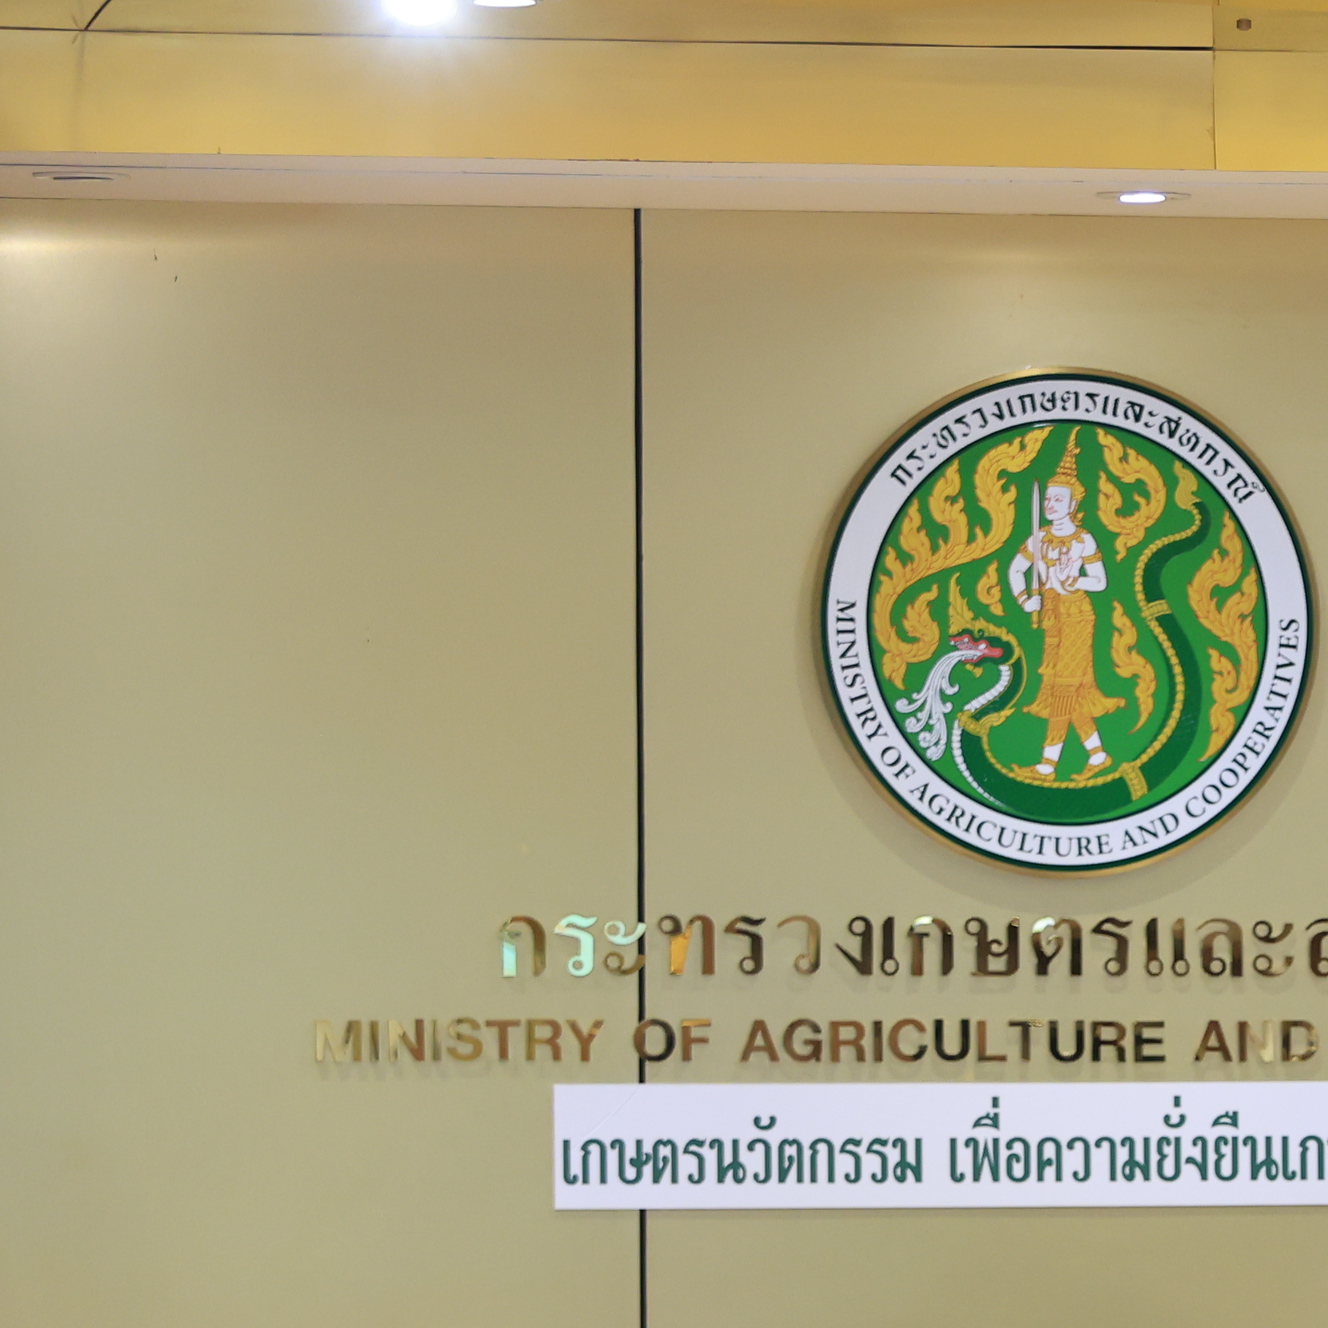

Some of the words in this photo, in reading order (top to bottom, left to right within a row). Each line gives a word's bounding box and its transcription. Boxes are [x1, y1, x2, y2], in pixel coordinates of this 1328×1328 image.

[890, 390, 1266, 504] กระทรวงเกษตรและสหกรณ์
[836, 599, 890, 742] MINISTRY
[880, 745, 916, 780] OF
[909, 781, 1114, 858] AGRICULTURE
[1120, 812, 1180, 851] AND
[1184, 618, 1300, 819] COOPERATIVES
[311, 1017, 605, 1064] MINISTRY
[633, 1017, 713, 1064] OF
[740, 1017, 1167, 1064] AGRICULTURE
[1194, 1018, 1319, 1063] AND
[562, 1115, 923, 1186] เกษตรนวัตกรรม
